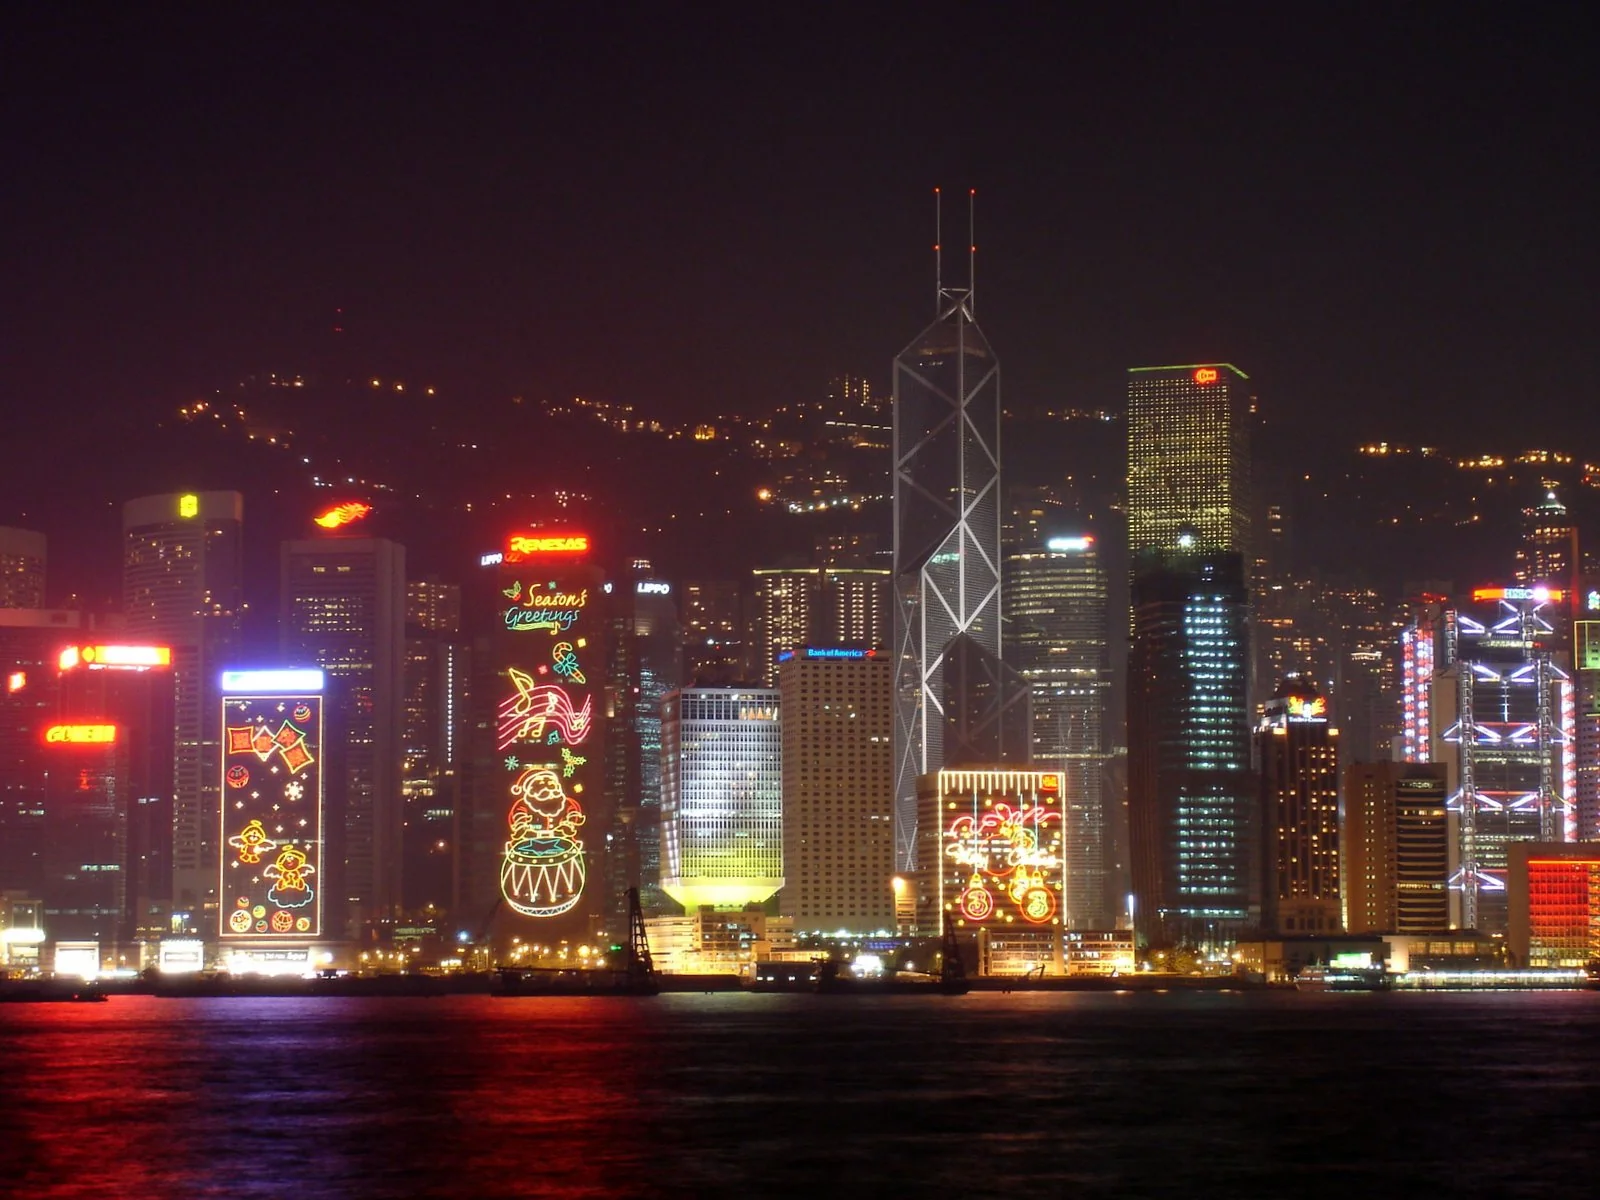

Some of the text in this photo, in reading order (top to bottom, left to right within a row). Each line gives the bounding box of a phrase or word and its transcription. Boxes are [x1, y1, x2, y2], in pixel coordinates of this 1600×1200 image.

[511, 537, 587, 554] RENESAS
[481, 553, 502, 566] LIPPO
[524, 583, 587, 607] Season's
[637, 582, 670, 595] LIPPO
[505, 606, 580, 631] Greetings
[808, 648, 825, 657] Bank
[834, 649, 863, 657] America
